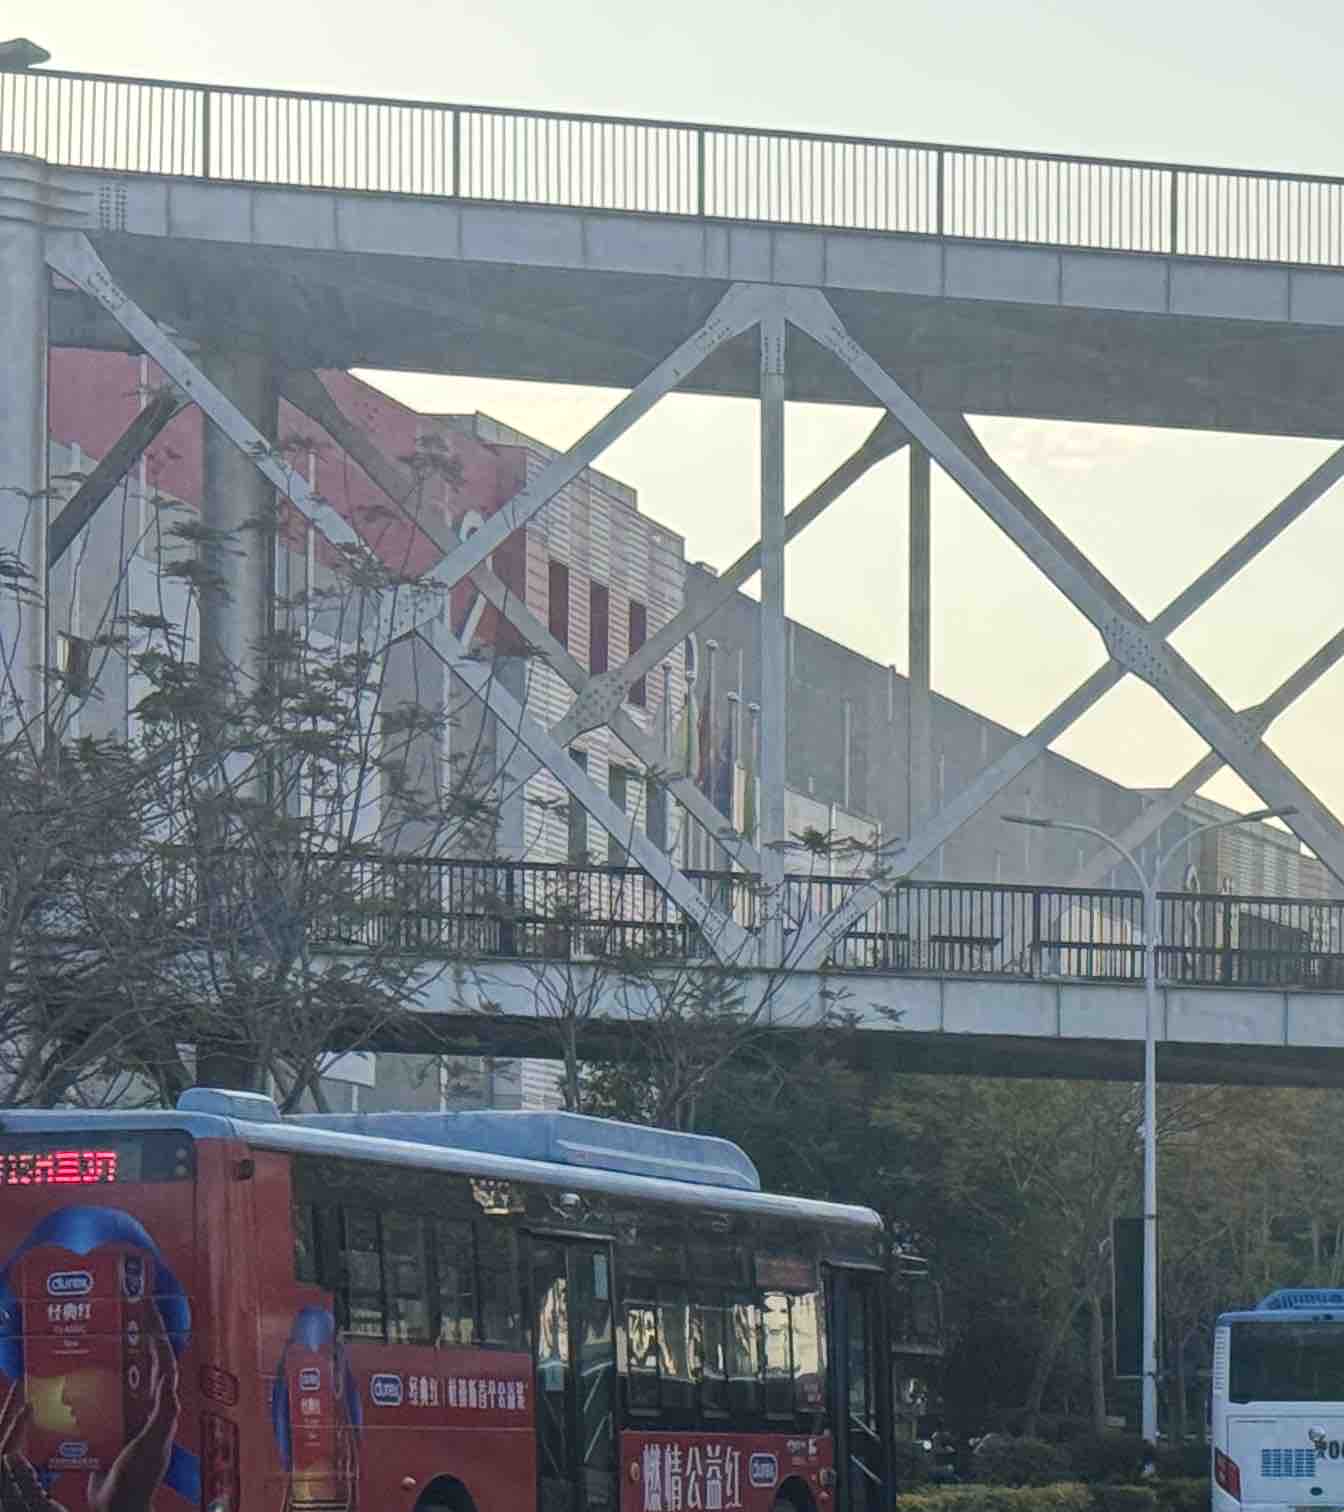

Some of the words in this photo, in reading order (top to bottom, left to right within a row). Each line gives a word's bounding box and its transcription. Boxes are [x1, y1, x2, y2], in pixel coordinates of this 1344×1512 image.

[643, 1444, 743, 1512] 燃情公益红
